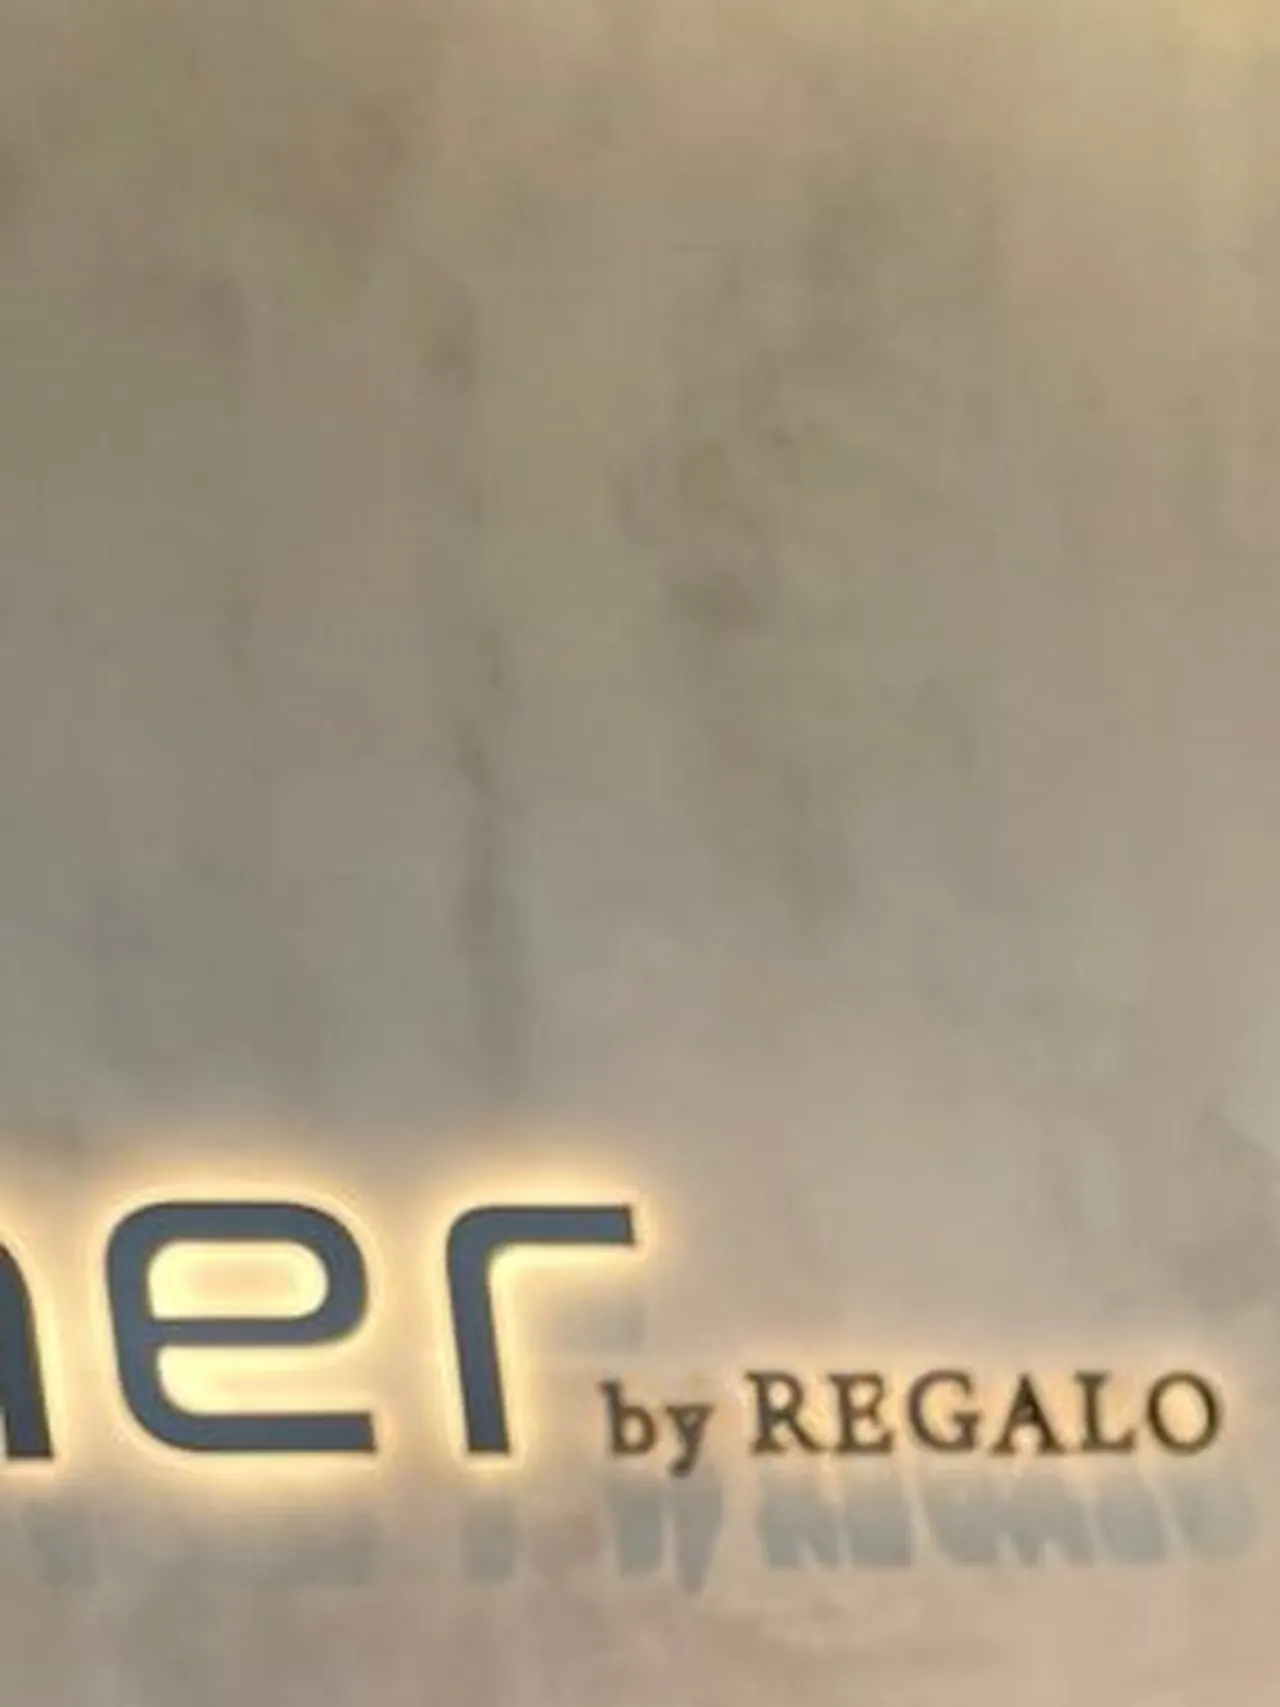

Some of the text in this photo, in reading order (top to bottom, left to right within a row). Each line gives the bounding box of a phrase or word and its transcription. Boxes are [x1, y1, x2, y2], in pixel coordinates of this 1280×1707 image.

[0, 1200, 1223, 1477] er by REGALO
